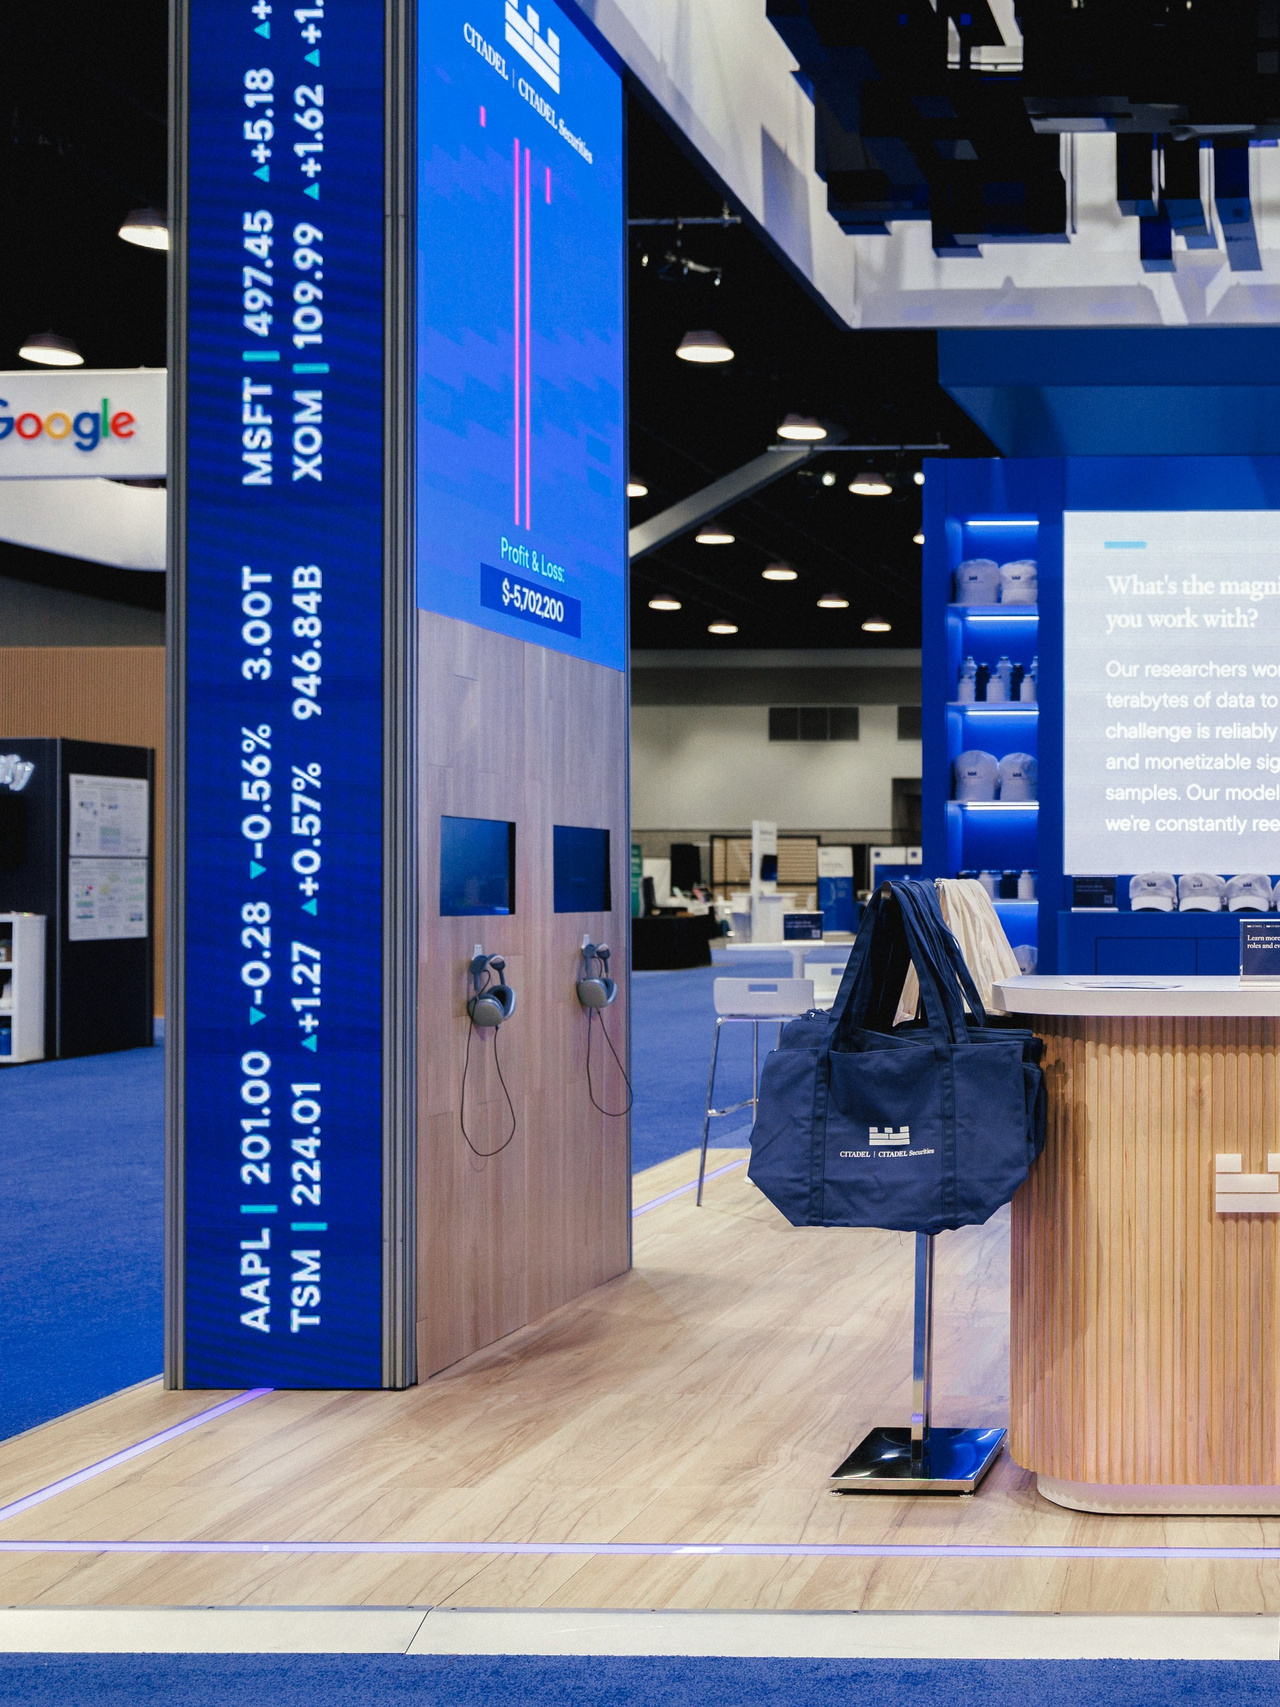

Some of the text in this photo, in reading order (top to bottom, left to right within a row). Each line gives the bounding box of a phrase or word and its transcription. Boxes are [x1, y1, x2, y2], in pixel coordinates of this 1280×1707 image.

[463, 22, 594, 165] CITADEL CITADEL Securities
[293, 84, 324, 179] +1.62
[292, 223, 324, 349] 109.99
[293, 391, 323, 482] XOM
[501, 536, 565, 583] Profit & Loss:
[502, 577, 564, 623] $-5,702,200
[1105, 573, 1177, 595] What's
[1182, 573, 1215, 595] the
[292, 566, 322, 721] 946.84B
[1105, 606, 1259, 635] you work with?
[1105, 660, 1140, 678] Our
[1144, 660, 1247, 678] researchers
[240, 69, 274, 1334] AAPL 201.00 -0.28 -0.56% 3.00T MSFT 497.45 +5.18
[1105, 691, 1189, 711] terabytes
[1193, 691, 1211, 708] of
[1216, 691, 1255, 708] data
[1260, 692, 1278, 708] to
[1105, 722, 1192, 742] challenge
[1197, 722, 1210, 739] is
[1215, 722, 1278, 742] reliably
[1105, 753, 1139, 770] and
[1144, 753, 1251, 770] monetizable
[1105, 784, 1182, 804] samples.
[1186, 783, 1220, 801] Our
[292, 763, 322, 897] +0.57%
[1155, 815, 1247, 836] constantly
[291, 942, 321, 1033] +1.27
[291, 1084, 322, 1206] 224.01
[840, 1148, 935, 1158] CITADEL CITADEL Securities
[290, 1249, 321, 1334] TSM
